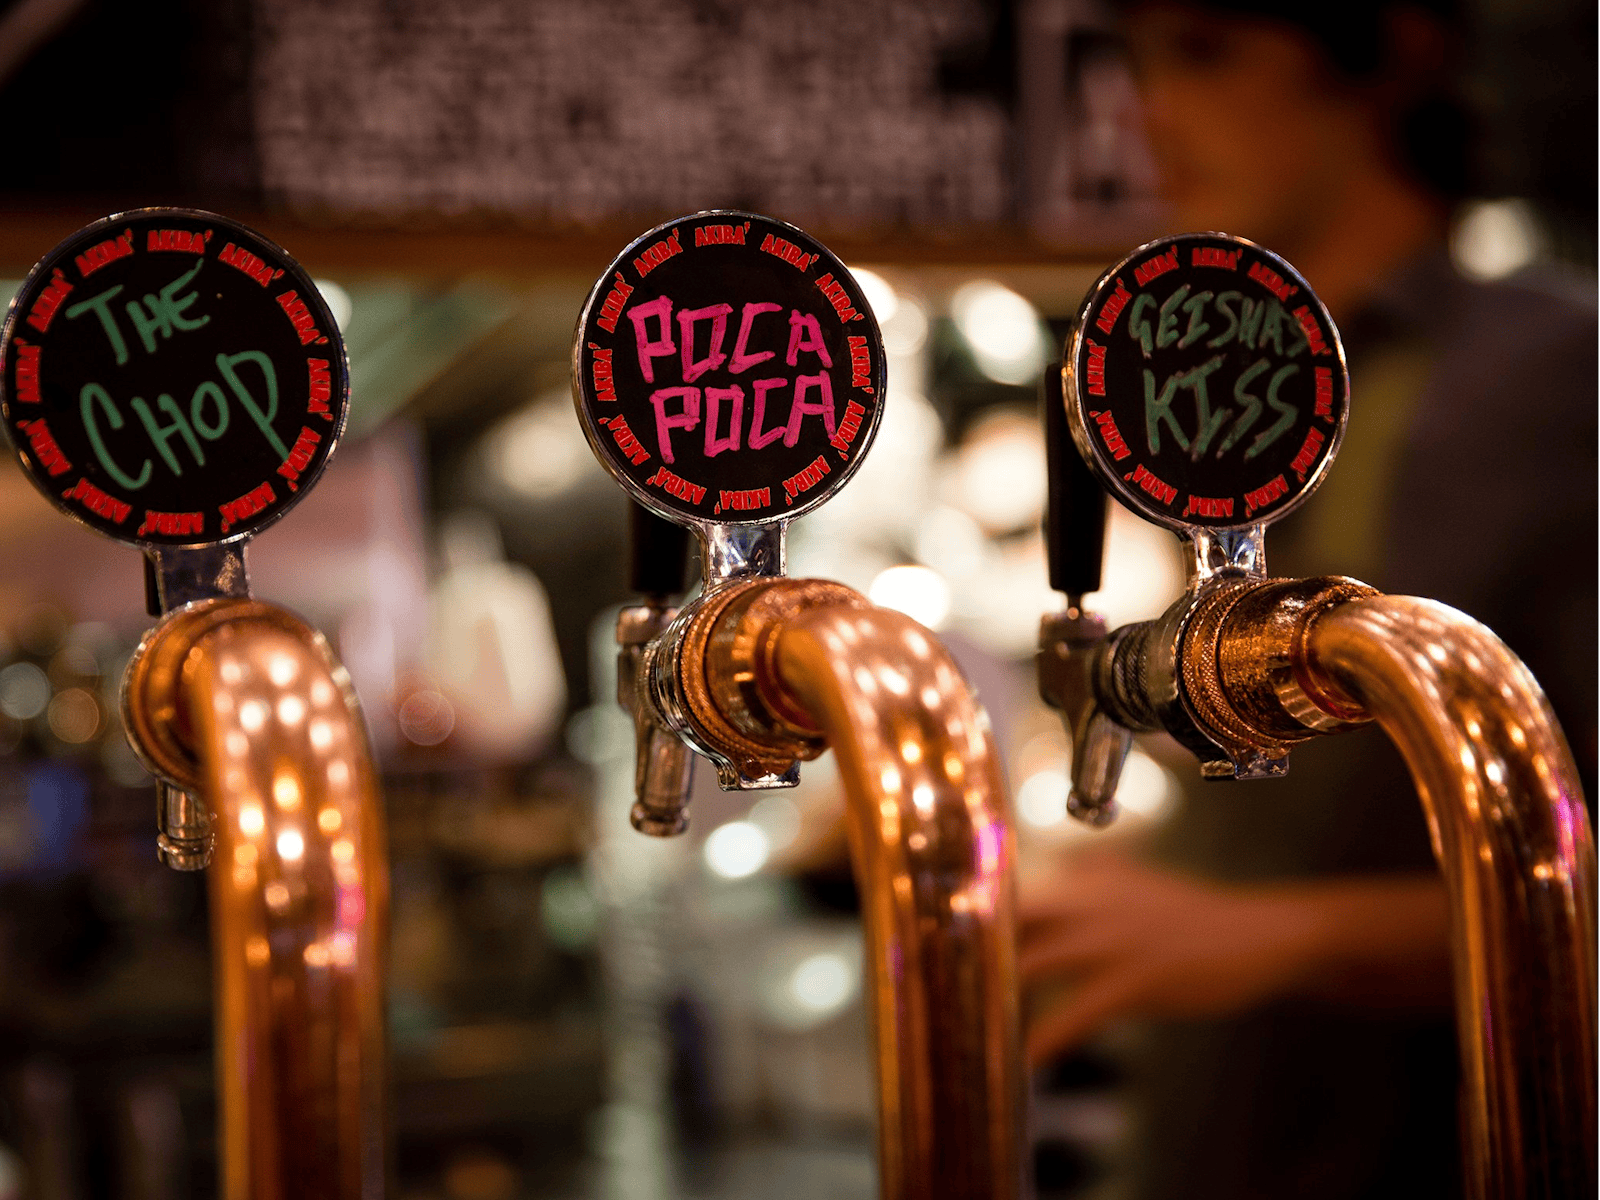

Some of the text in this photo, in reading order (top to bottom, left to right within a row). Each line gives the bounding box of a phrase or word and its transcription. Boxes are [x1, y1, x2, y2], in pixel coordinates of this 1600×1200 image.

[66, 257, 211, 365] THE
[626, 295, 834, 384] POCA
[79, 350, 290, 489] CHOP
[649, 369, 838, 464] POCA
[1142, 353, 1300, 463] KISS
